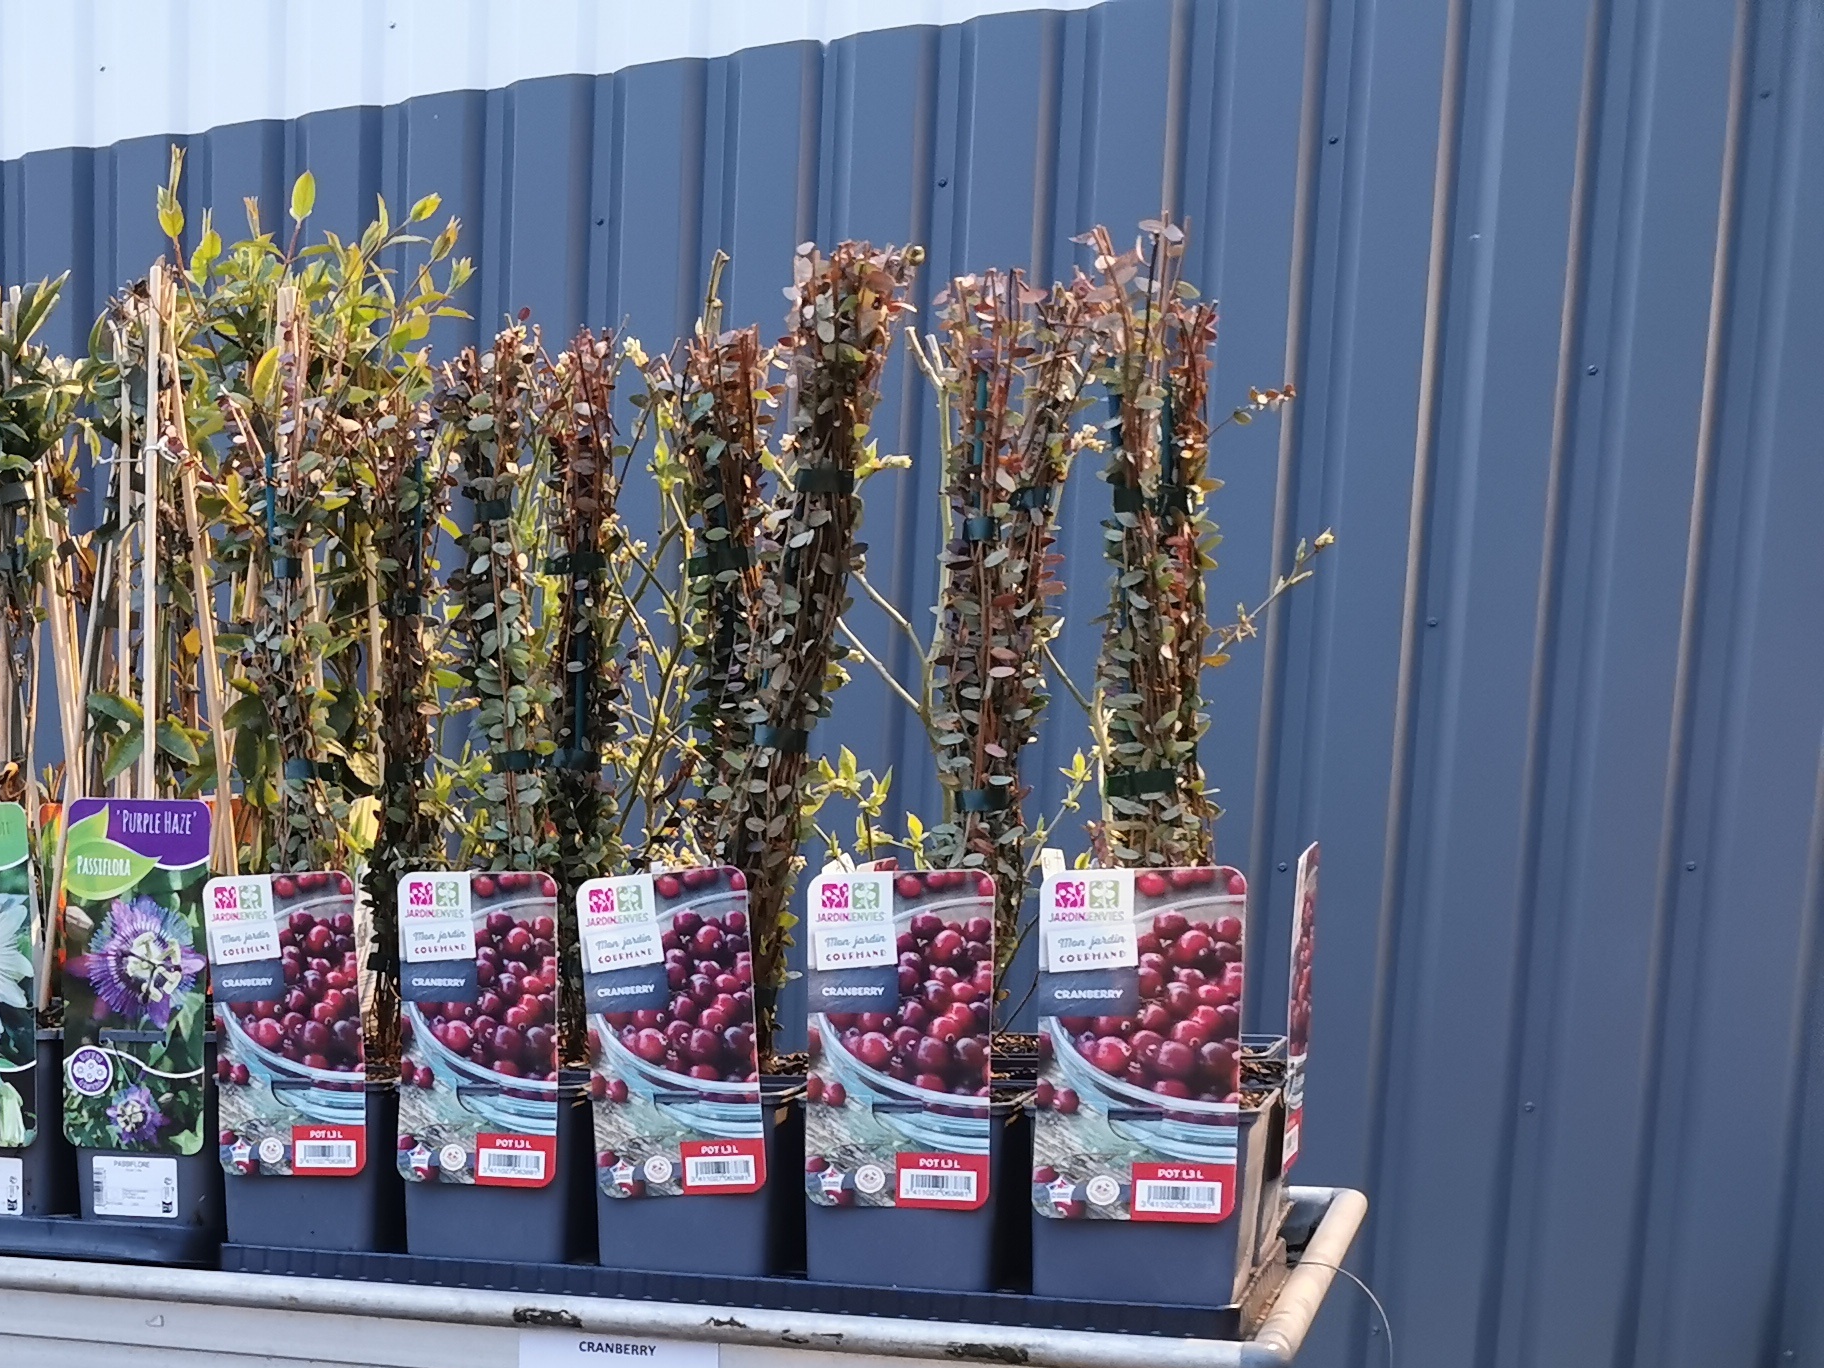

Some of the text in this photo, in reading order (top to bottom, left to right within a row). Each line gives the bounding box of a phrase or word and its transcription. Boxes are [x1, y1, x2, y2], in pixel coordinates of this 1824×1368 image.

[77, 855, 131, 876] PASSIFLORA
[1057, 934, 1126, 950] Mon jardin
[597, 983, 655, 998] CRANBERRY
[821, 986, 885, 996] CRANBERRY
[1054, 989, 1124, 999] CRANBERRY
[919, 1158, 939, 1168] POT
[1157, 1168, 1180, 1179] POT
[578, 1340, 656, 1356] CRANBERRY
